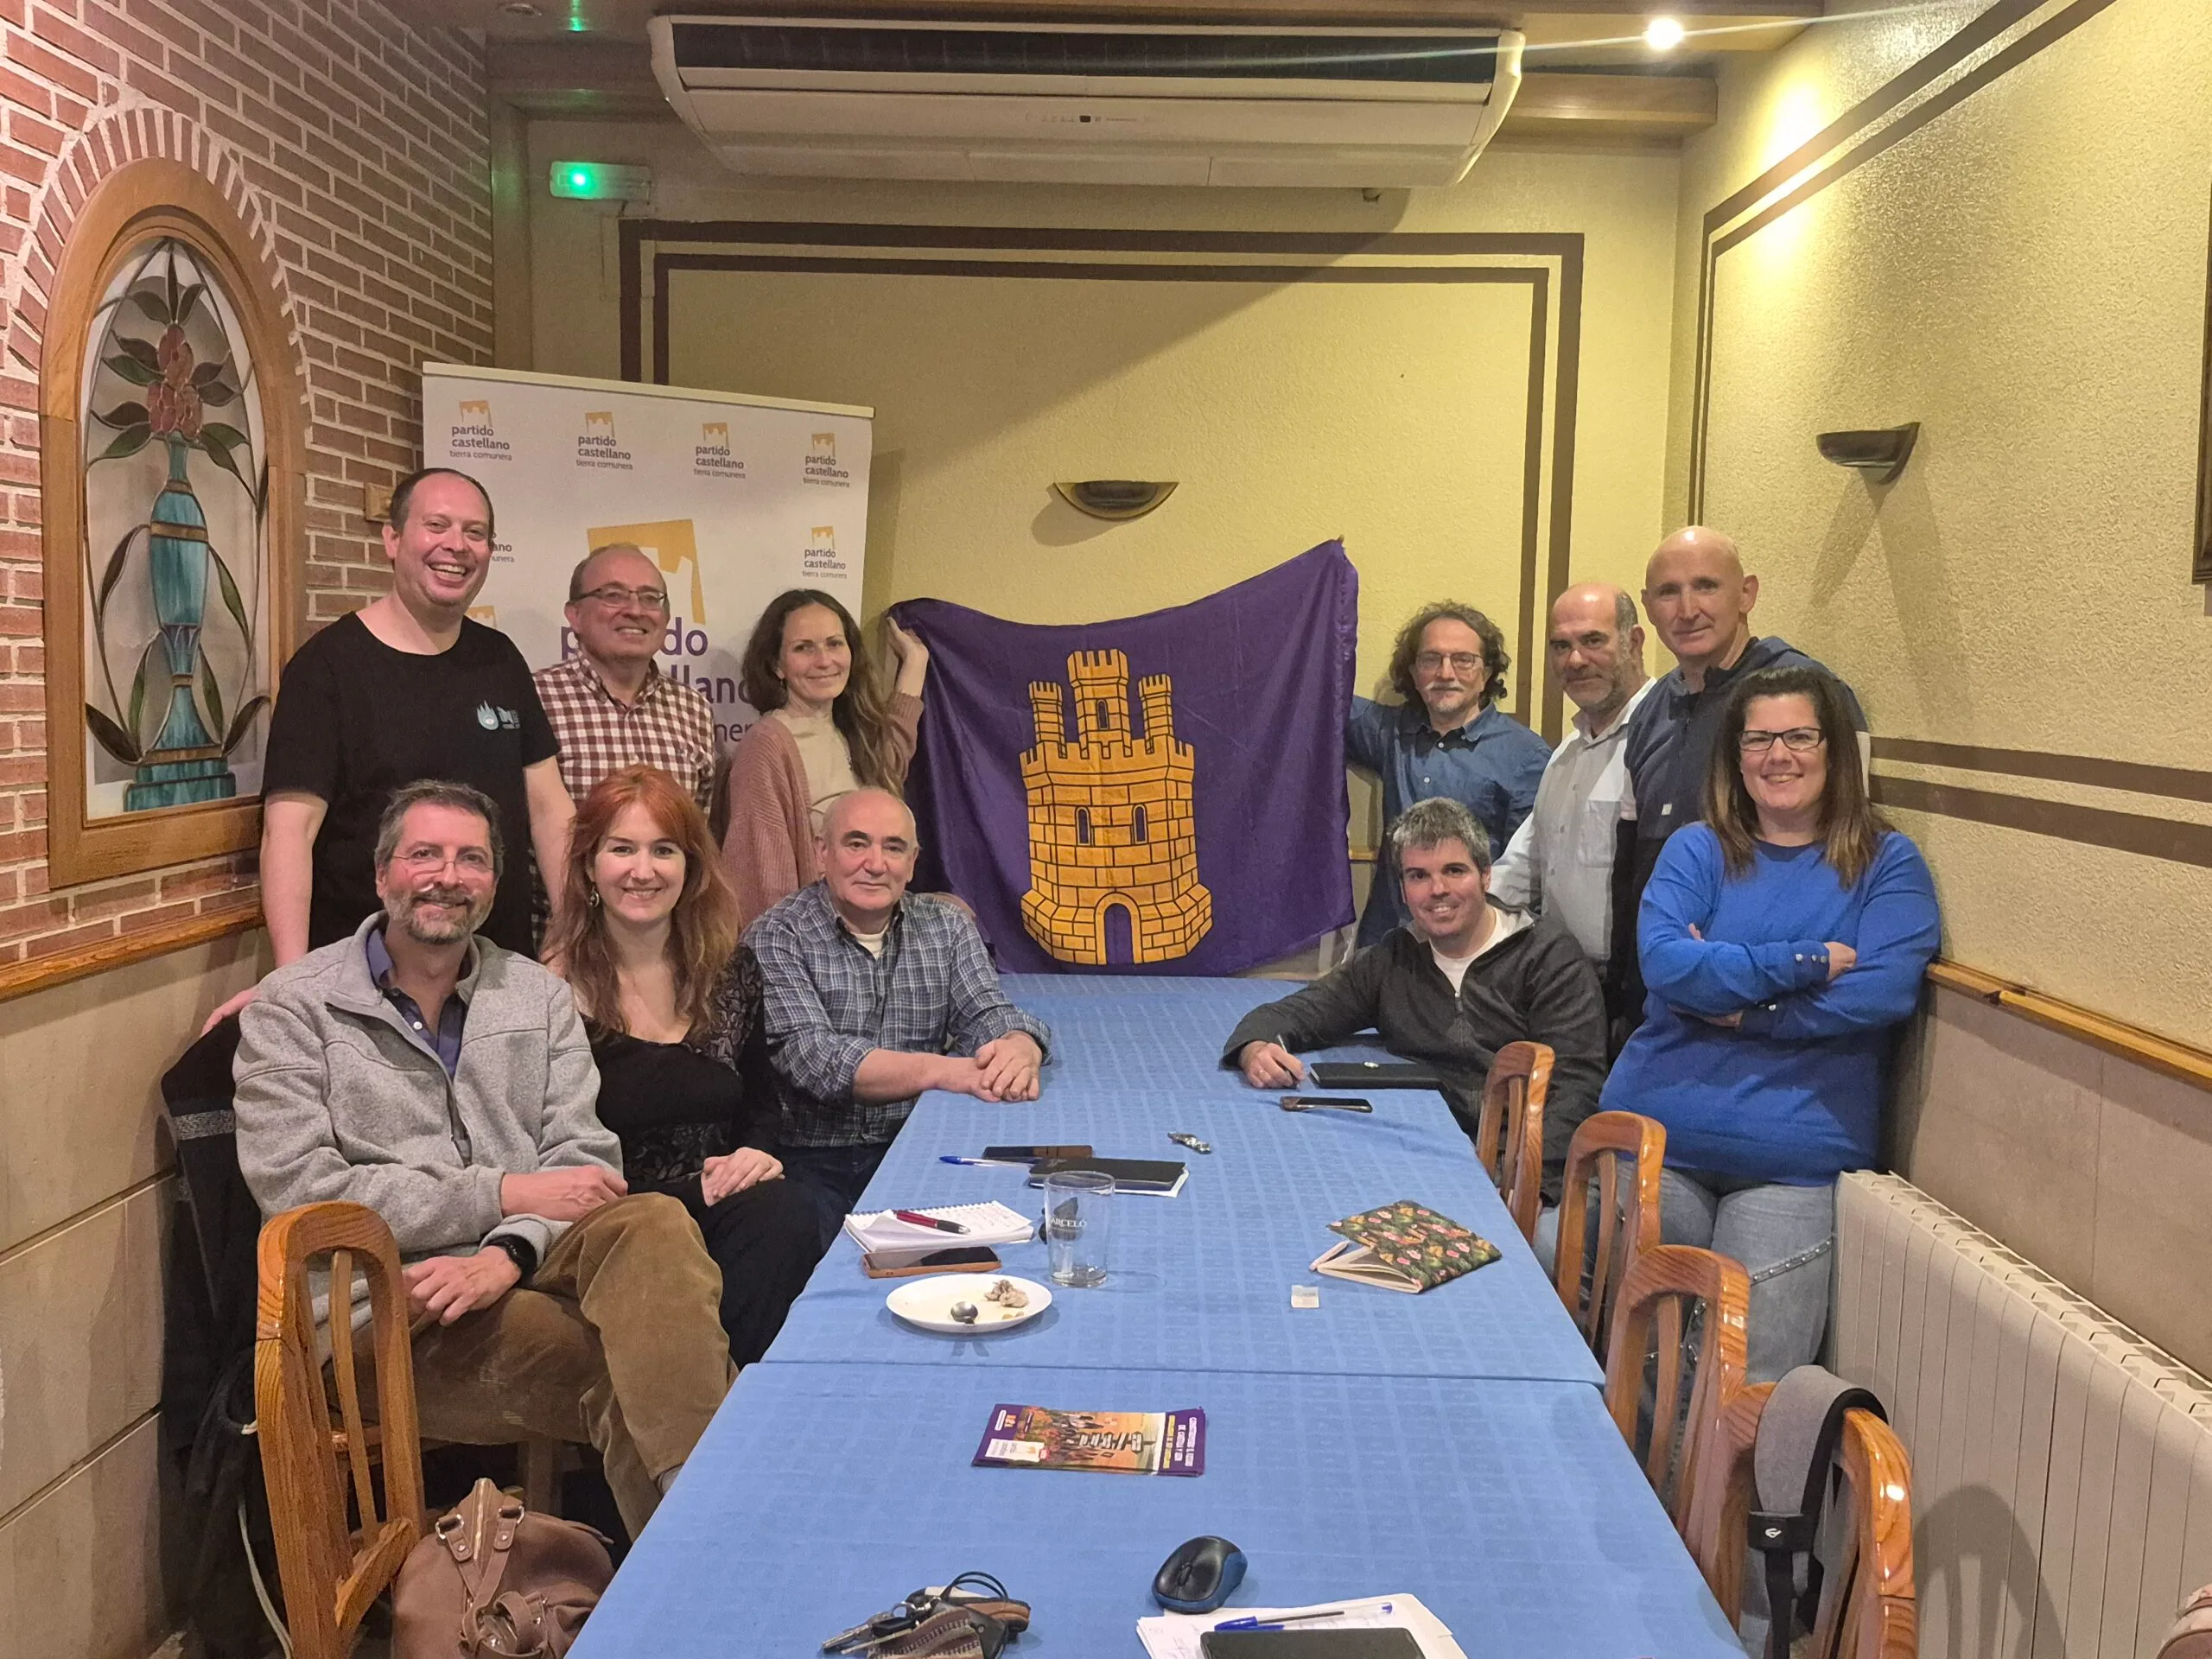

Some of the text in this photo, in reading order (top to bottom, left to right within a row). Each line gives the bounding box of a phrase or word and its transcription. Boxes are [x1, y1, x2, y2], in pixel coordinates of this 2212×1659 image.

[451, 424, 494, 437] partido
[452, 437, 510, 450] castellano
[578, 435, 617, 447] partido
[473, 452, 512, 461] comunera
[578, 448, 632, 460] castellano
[696, 446, 731, 456] partido
[696, 457, 745, 469] castellano
[804, 455, 837, 466] partido
[805, 467, 849, 479] castellano
[804, 547, 836, 559] partido
[804, 560, 847, 569] castellano
[1051, 1217, 1088, 1228] ARCELÓ
